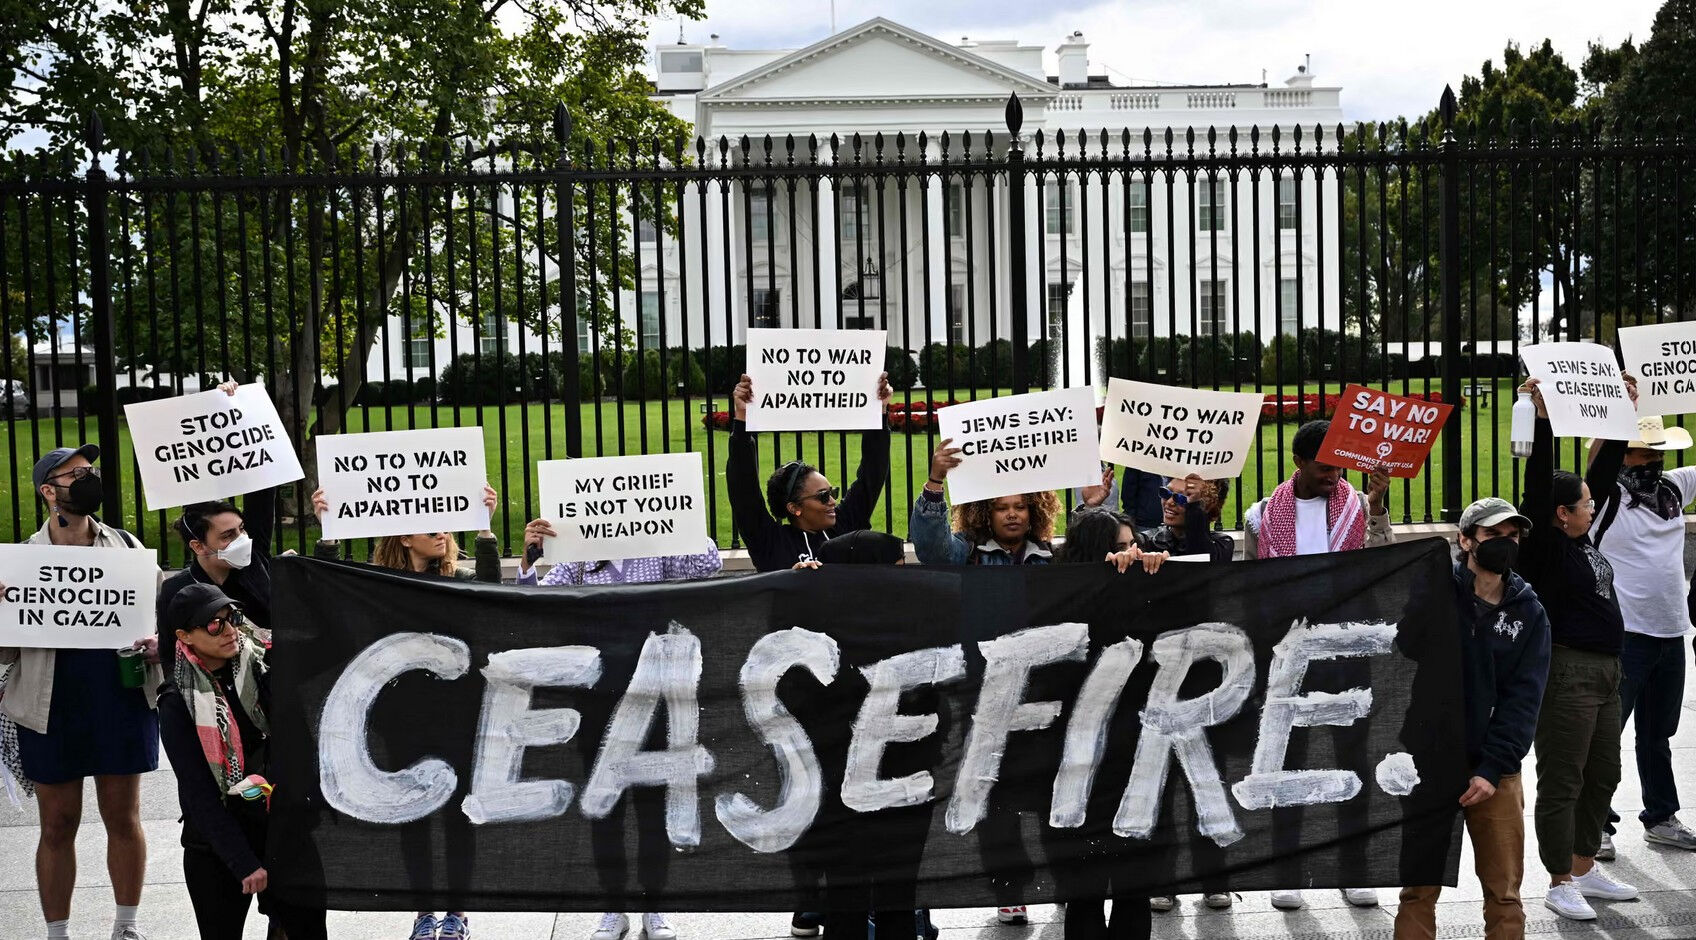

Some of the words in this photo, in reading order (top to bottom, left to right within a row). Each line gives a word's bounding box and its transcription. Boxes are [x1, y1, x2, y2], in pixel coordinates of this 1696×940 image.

[761, 348, 790, 364] NO
[796, 348, 822, 365] TO
[829, 349, 872, 365] WAR
[787, 370, 814, 386] NO
[820, 370, 847, 386] TO
[1547, 360, 1587, 375] JEWS
[1590, 362, 1616, 377] SAY:
[1555, 380, 1622, 399] CEASEFIRE
[1651, 380, 1668, 396] IN
[760, 392, 869, 409] APARTHEID
[1121, 398, 1153, 417] NO
[1160, 404, 1189, 422] TO
[1197, 408, 1246, 426] WAR
[1352, 391, 1406, 418] SAY
[1407, 404, 1439, 425] NO
[1579, 403, 1608, 419] NOW
[180, 408, 243, 437] STOP
[961, 413, 1021, 435] JEWS
[1028, 406, 1074, 426] SAY:
[1349, 412, 1378, 434] TO
[1383, 422, 1432, 444] WAR!
[154, 423, 276, 463] GENOCIDE
[961, 428, 1079, 456] CEASEFIRE
[1145, 422, 1179, 441] NO
[1187, 428, 1214, 445] TO
[334, 455, 369, 473] NO
[376, 453, 406, 471] TO
[413, 449, 468, 468] WAR
[995, 453, 1048, 474] NOW
[1115, 438, 1235, 466] APARTHEID
[1334, 448, 1381, 465] COMMUNIST
[173, 463, 200, 483] IN
[206, 447, 275, 477] GAZA
[367, 475, 401, 493] NO
[408, 473, 438, 491] TO
[576, 478, 605, 493] MY
[612, 472, 674, 492] GRIEF
[337, 495, 470, 519] APARTHEID
[559, 502, 577, 519] IS
[585, 498, 629, 516] NOT
[634, 495, 693, 514] YOUR
[578, 517, 674, 540] WEAPON
[38, 565, 105, 584] STOP
[4, 586, 136, 606] GENOCIDE
[18, 609, 44, 626] IN
[53, 610, 122, 628] GAZA
[317, 618, 1422, 852] CEASEFIRE.
